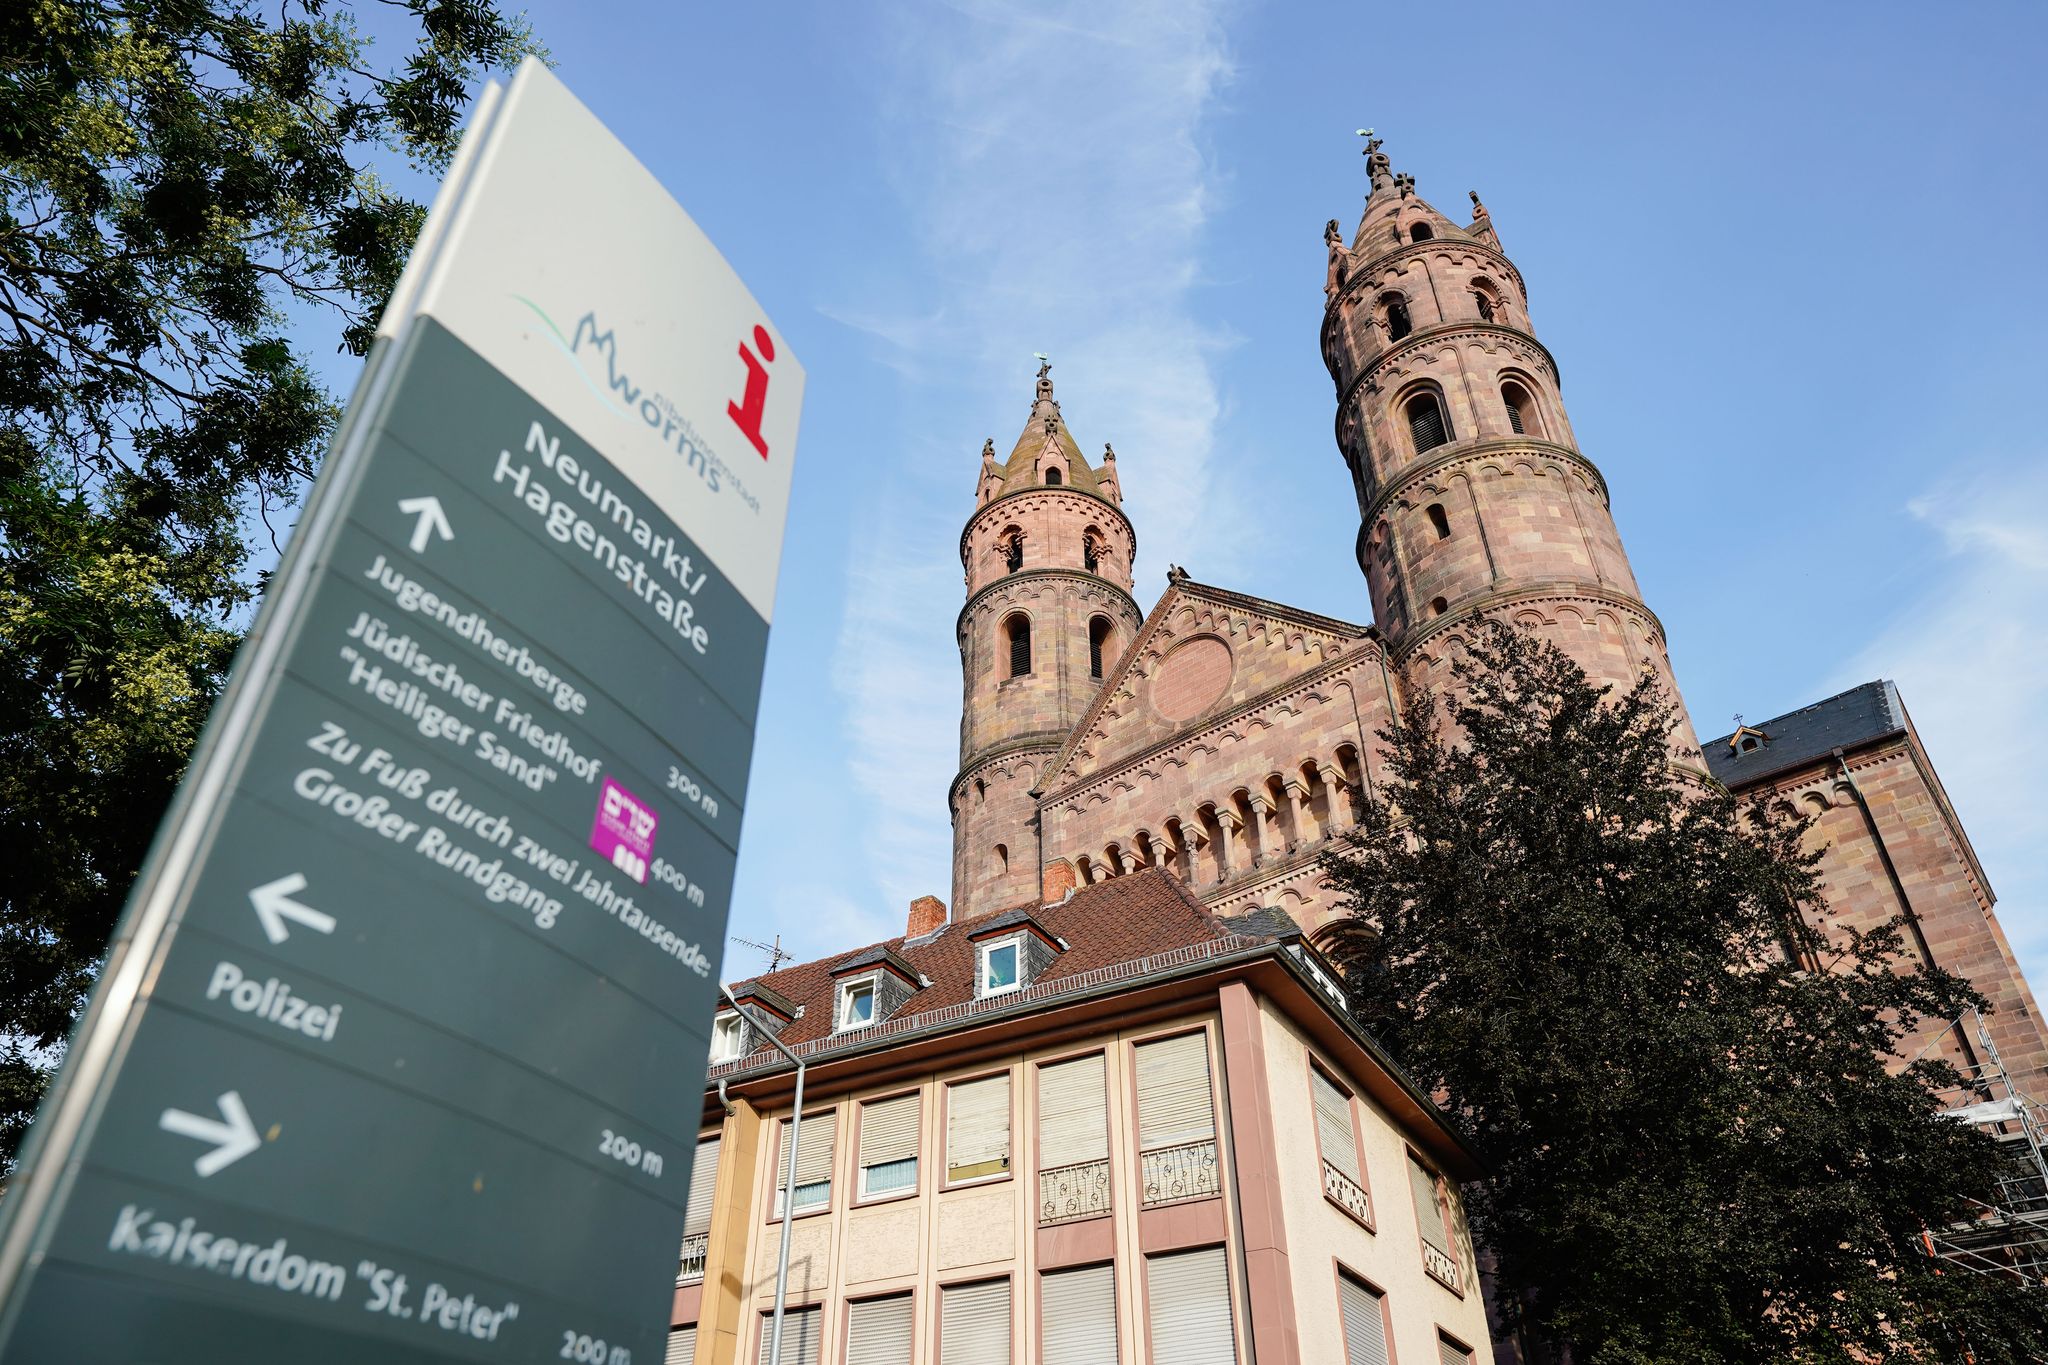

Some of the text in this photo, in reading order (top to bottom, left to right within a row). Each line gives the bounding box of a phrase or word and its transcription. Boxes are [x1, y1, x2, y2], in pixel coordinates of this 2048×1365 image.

[493, 450, 709, 653] Hagenstraße
[525, 421, 708, 595] Neumarkt/
[347, 612, 602, 783] Jüdischer Friedhof
[365, 555, 587, 714] Jugendherberge
[294, 767, 419, 843] Großer
[417, 826, 564, 929] Rundgang
[307, 721, 712, 977] Zu Fuß durch zwei Jahrtausende:
[667, 765, 719, 818] 300 m
[650, 857, 705, 907] 400 m
[206, 961, 343, 1042] Polizei
[599, 1129, 663, 1178] 200 m
[108, 1205, 347, 1301] Kaiserdom
[420, 1283, 520, 1341] Peter"
[560, 1330, 632, 1365] 200 m
